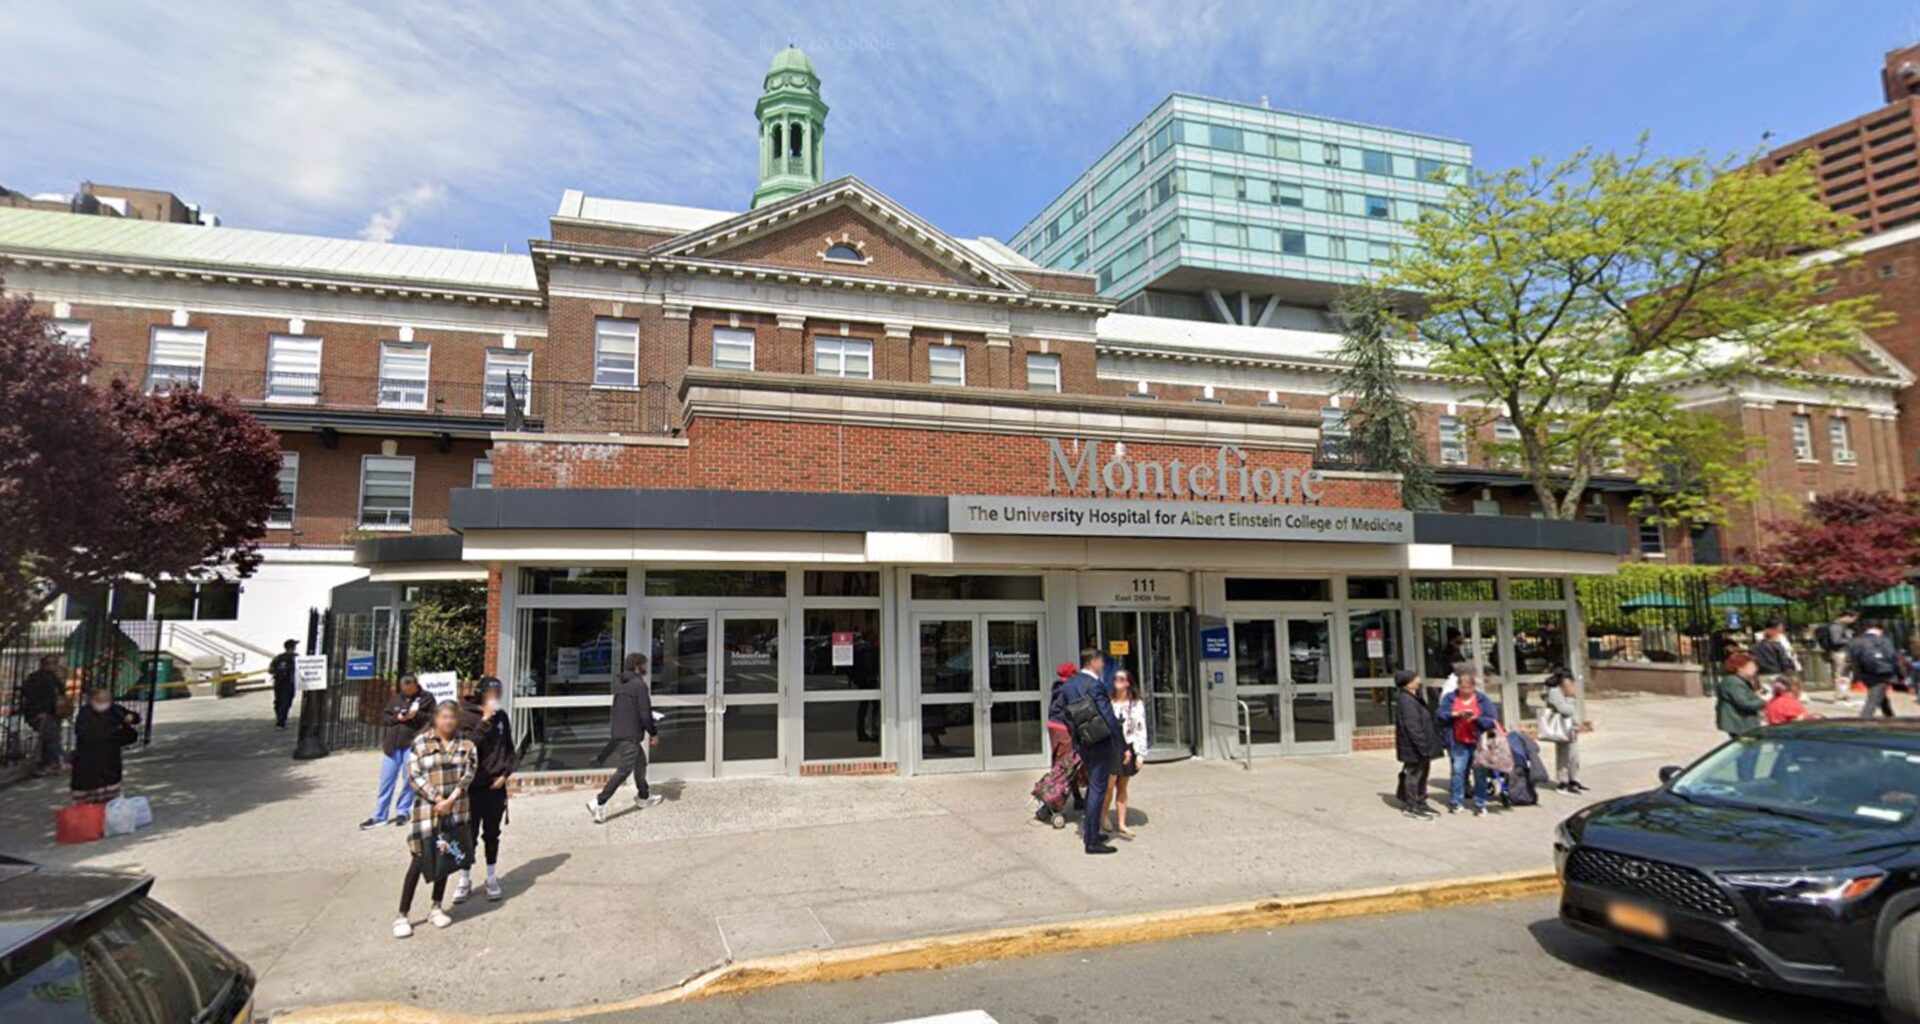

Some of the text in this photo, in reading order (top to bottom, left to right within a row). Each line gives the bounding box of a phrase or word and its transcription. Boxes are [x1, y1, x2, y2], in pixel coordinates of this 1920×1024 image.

[1042, 437, 1324, 501] Montefiore
[967, 506, 1403, 533] The University Hospital for Albert Einstein College of Medicine
[1131, 578, 1155, 592] 111
[426, 681, 450, 689] Visitor
